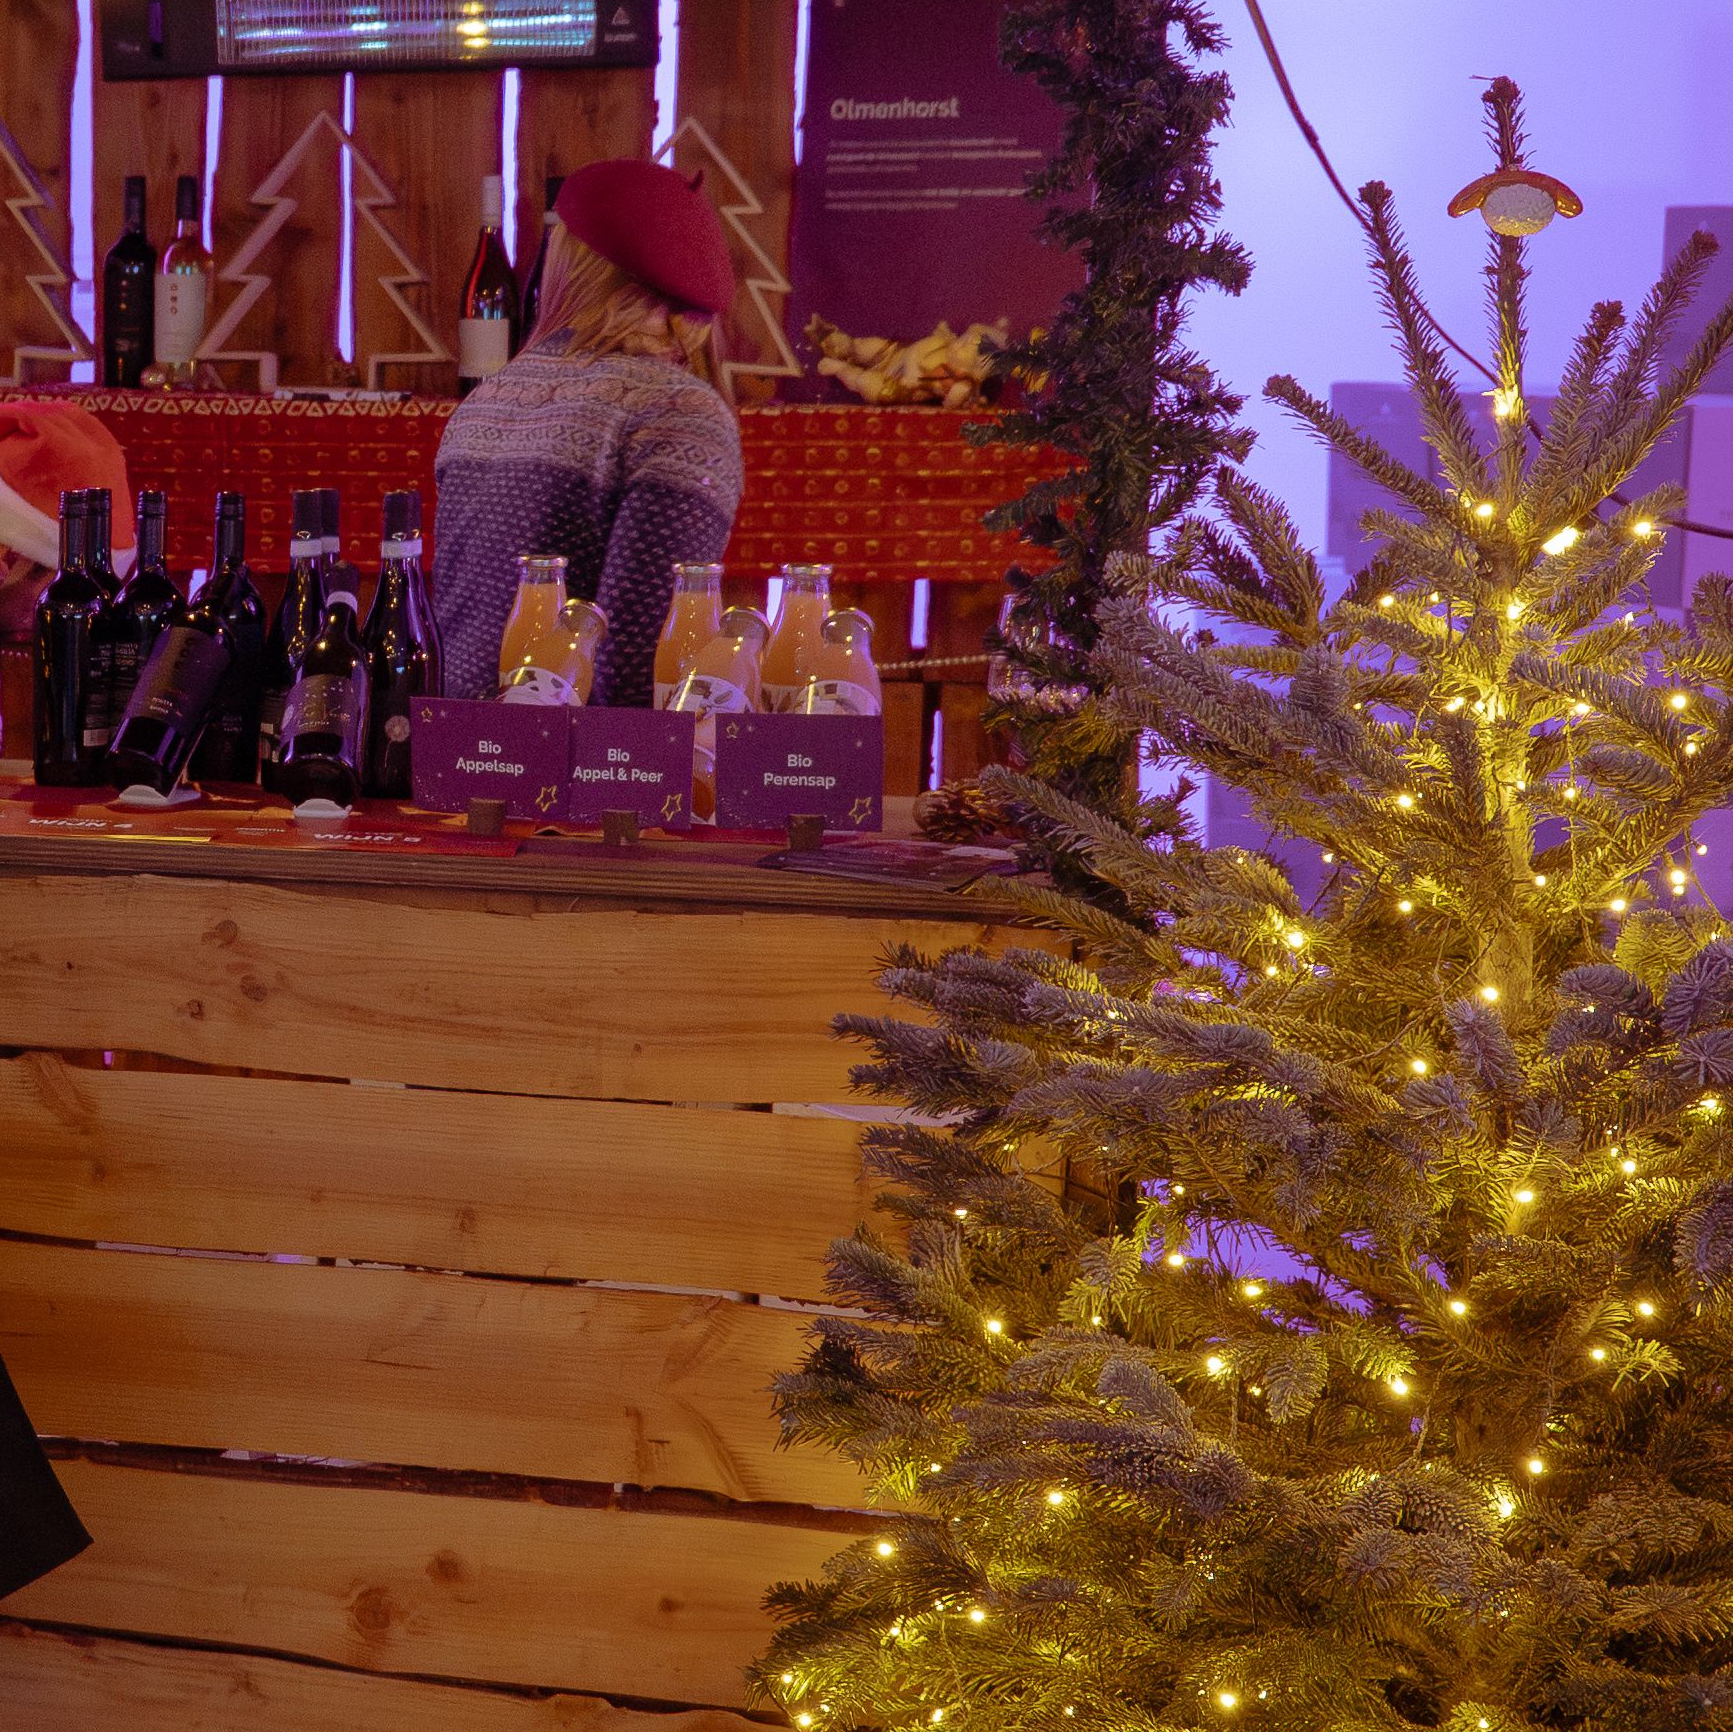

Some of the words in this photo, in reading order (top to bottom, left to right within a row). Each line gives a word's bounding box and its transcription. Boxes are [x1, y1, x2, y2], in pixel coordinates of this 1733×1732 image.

[830, 95, 961, 121] Olmenhorst
[478, 740, 502, 755] Bio
[607, 748, 630, 763] Bio
[455, 757, 525, 777] Appelsap
[787, 753, 813, 768] Bio
[572, 765, 615, 783] Appel
[617, 767, 628, 782] &
[631, 768, 664, 784] Peer
[763, 771, 836, 790] Perensap
[314, 832, 395, 841] WIJN
